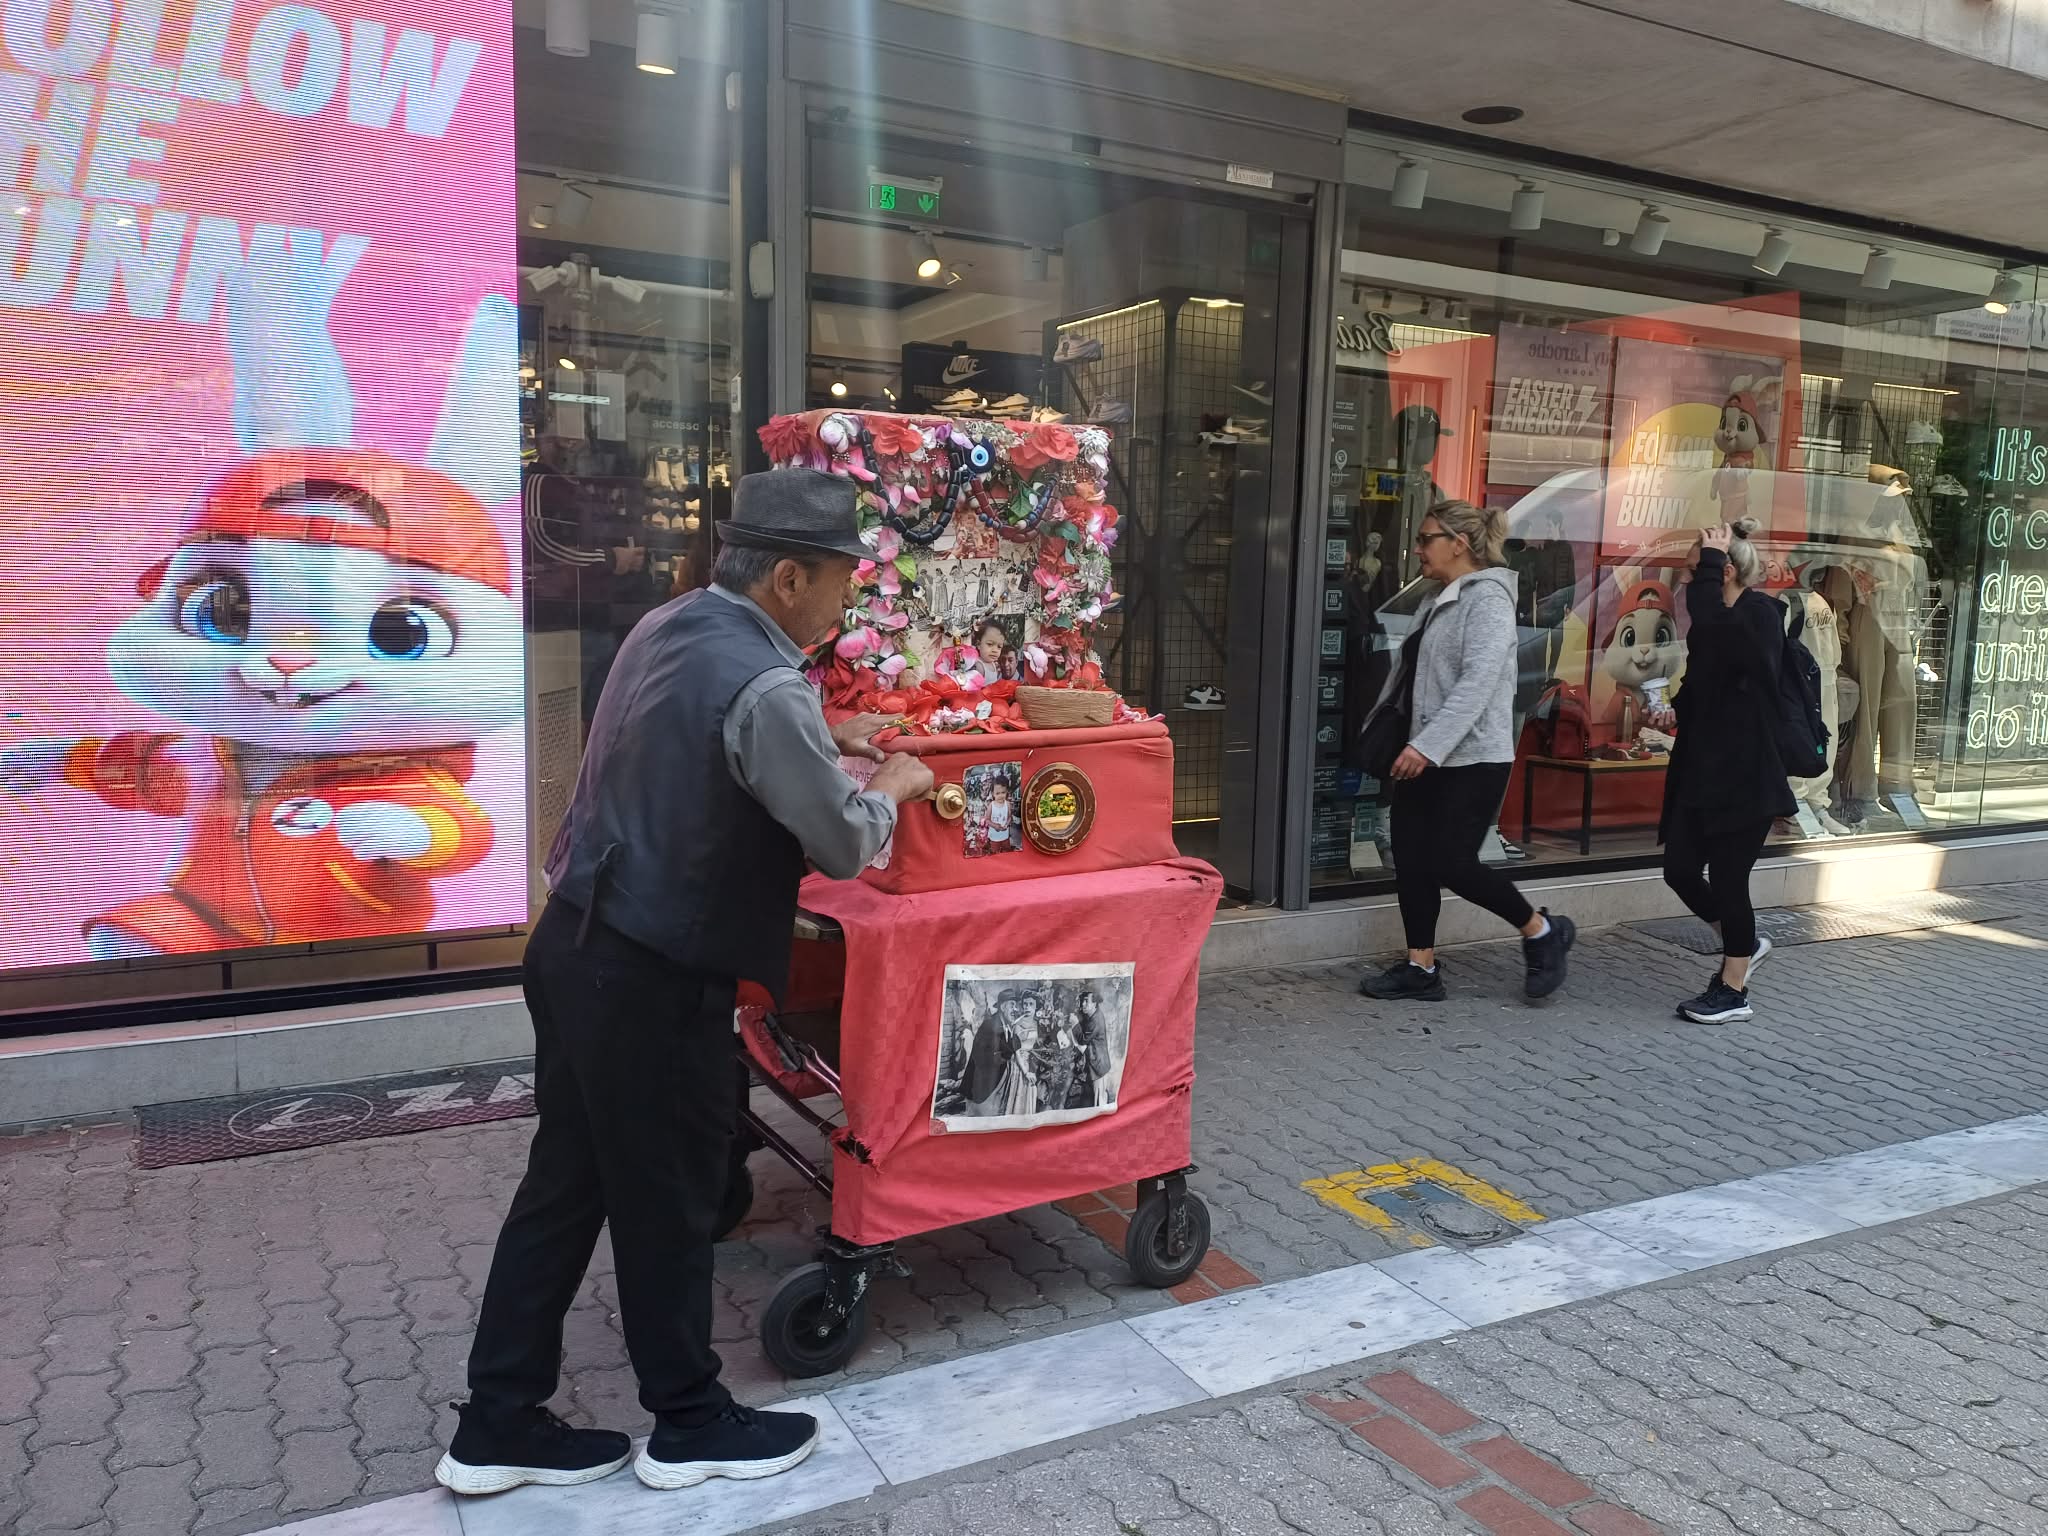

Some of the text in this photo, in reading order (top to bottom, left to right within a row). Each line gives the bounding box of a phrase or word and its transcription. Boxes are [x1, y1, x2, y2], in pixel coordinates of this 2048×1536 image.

[949, 355, 978, 374] NIKE
[1505, 376, 1575, 411] EASTER
[1500, 403, 1575, 436] ENERGY
[1993, 427, 2047, 486] It's
[1627, 463, 1665, 496] THE
[1616, 495, 1692, 529] BUNNY
[1980, 558, 2048, 615] dre
